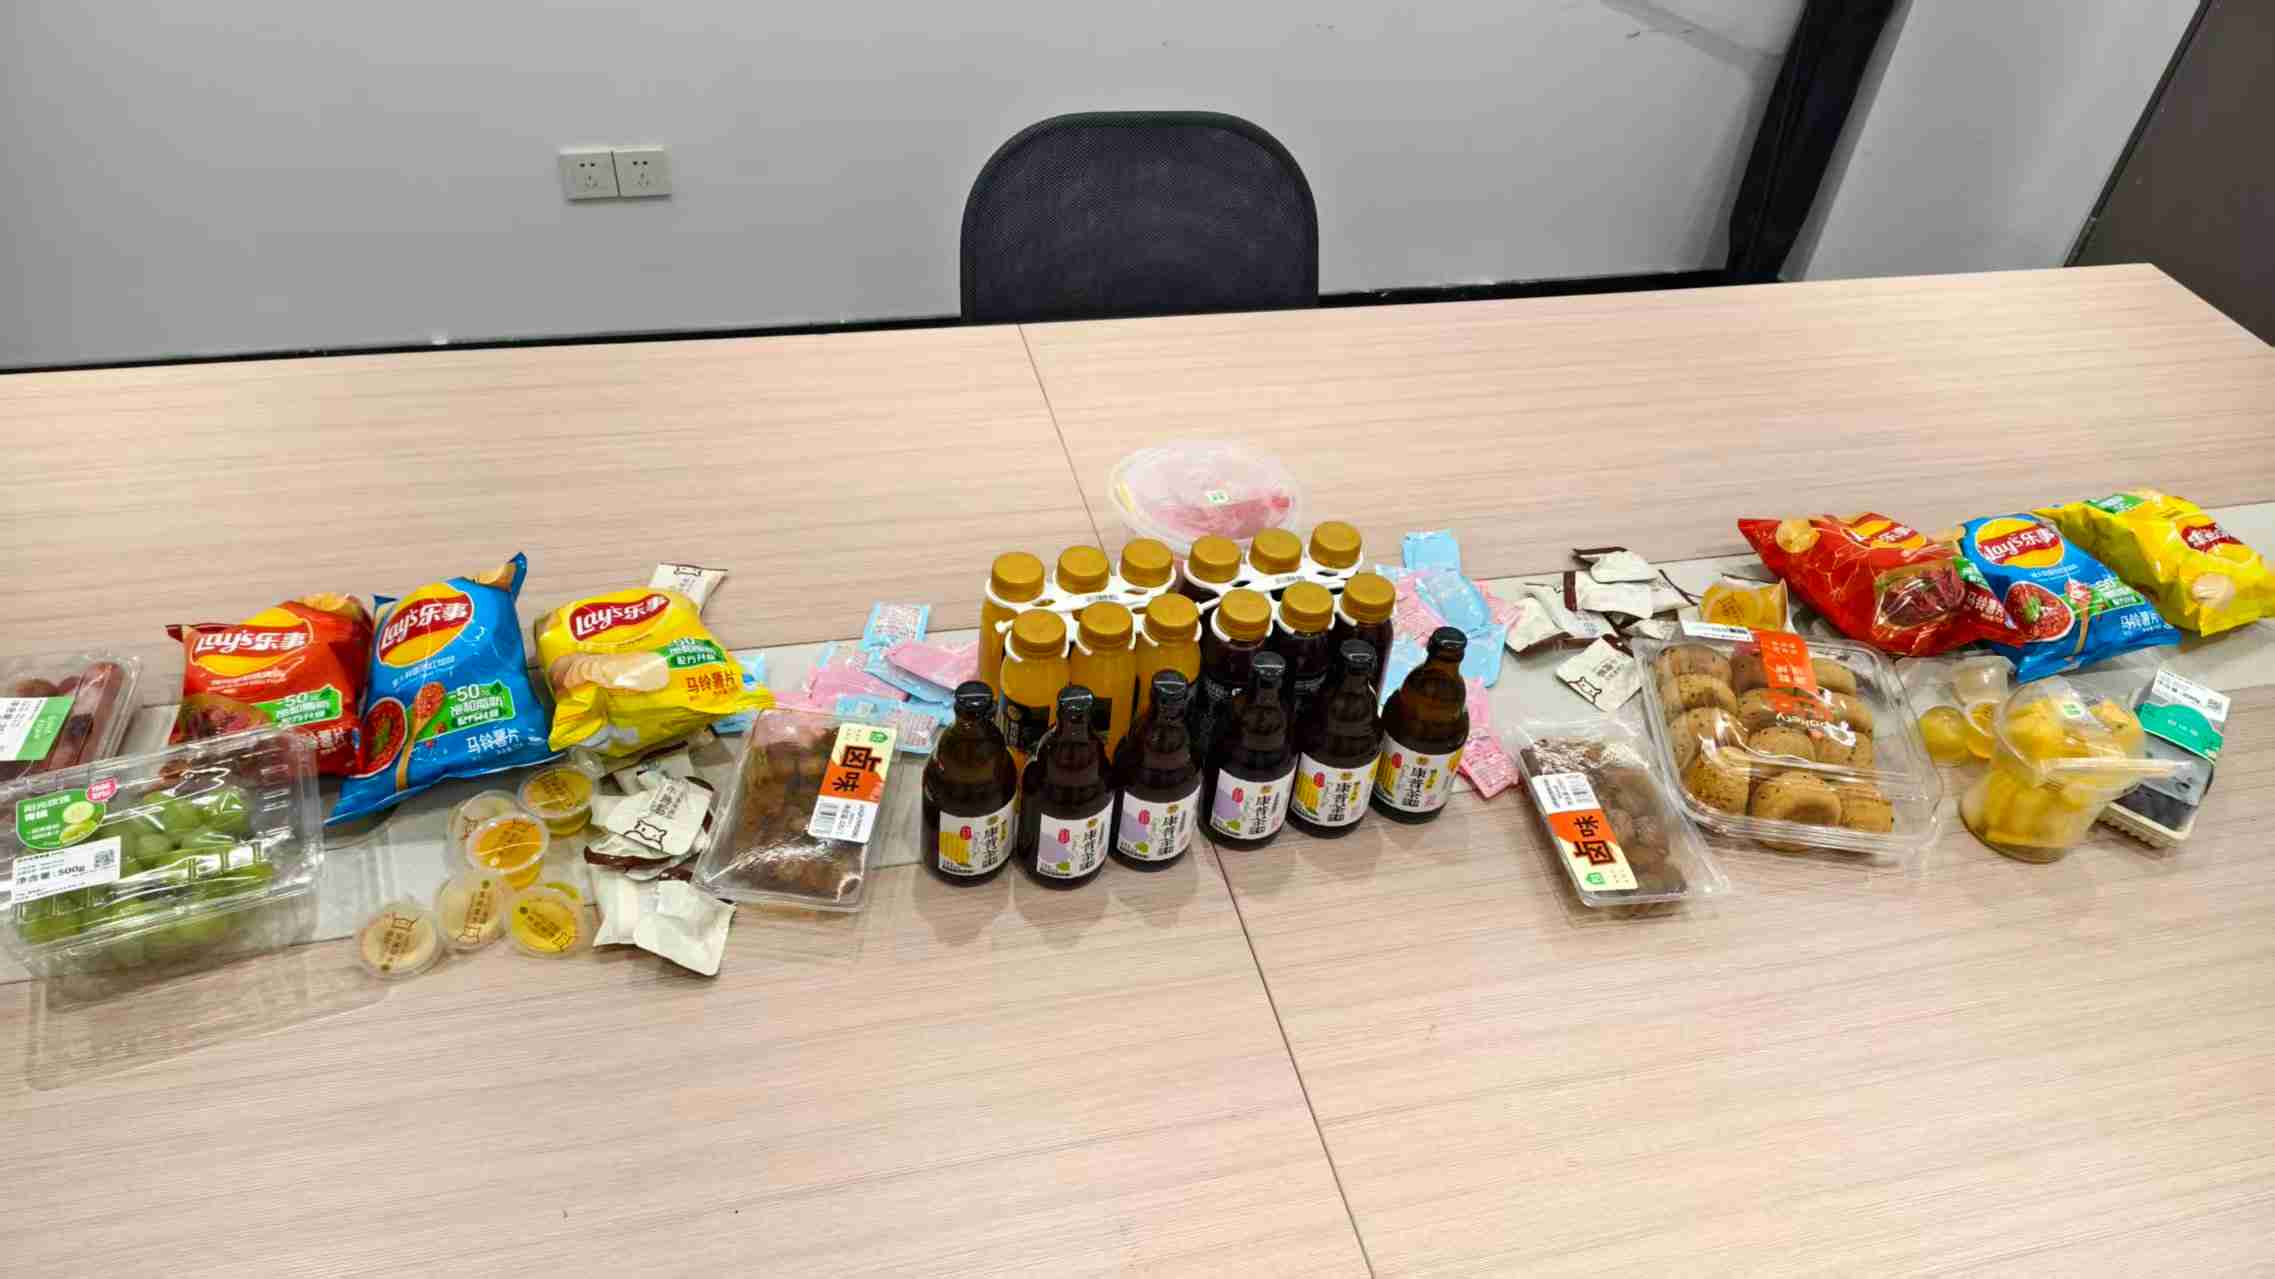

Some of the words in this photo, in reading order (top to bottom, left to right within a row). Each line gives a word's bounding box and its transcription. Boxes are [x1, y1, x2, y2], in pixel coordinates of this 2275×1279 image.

[686, 671, 735, 693] 马铃薯片
[465, 727, 521, 753] 马铃薯片
[832, 745, 882, 792] 卤味
[1573, 815, 1616, 866] 卤味
